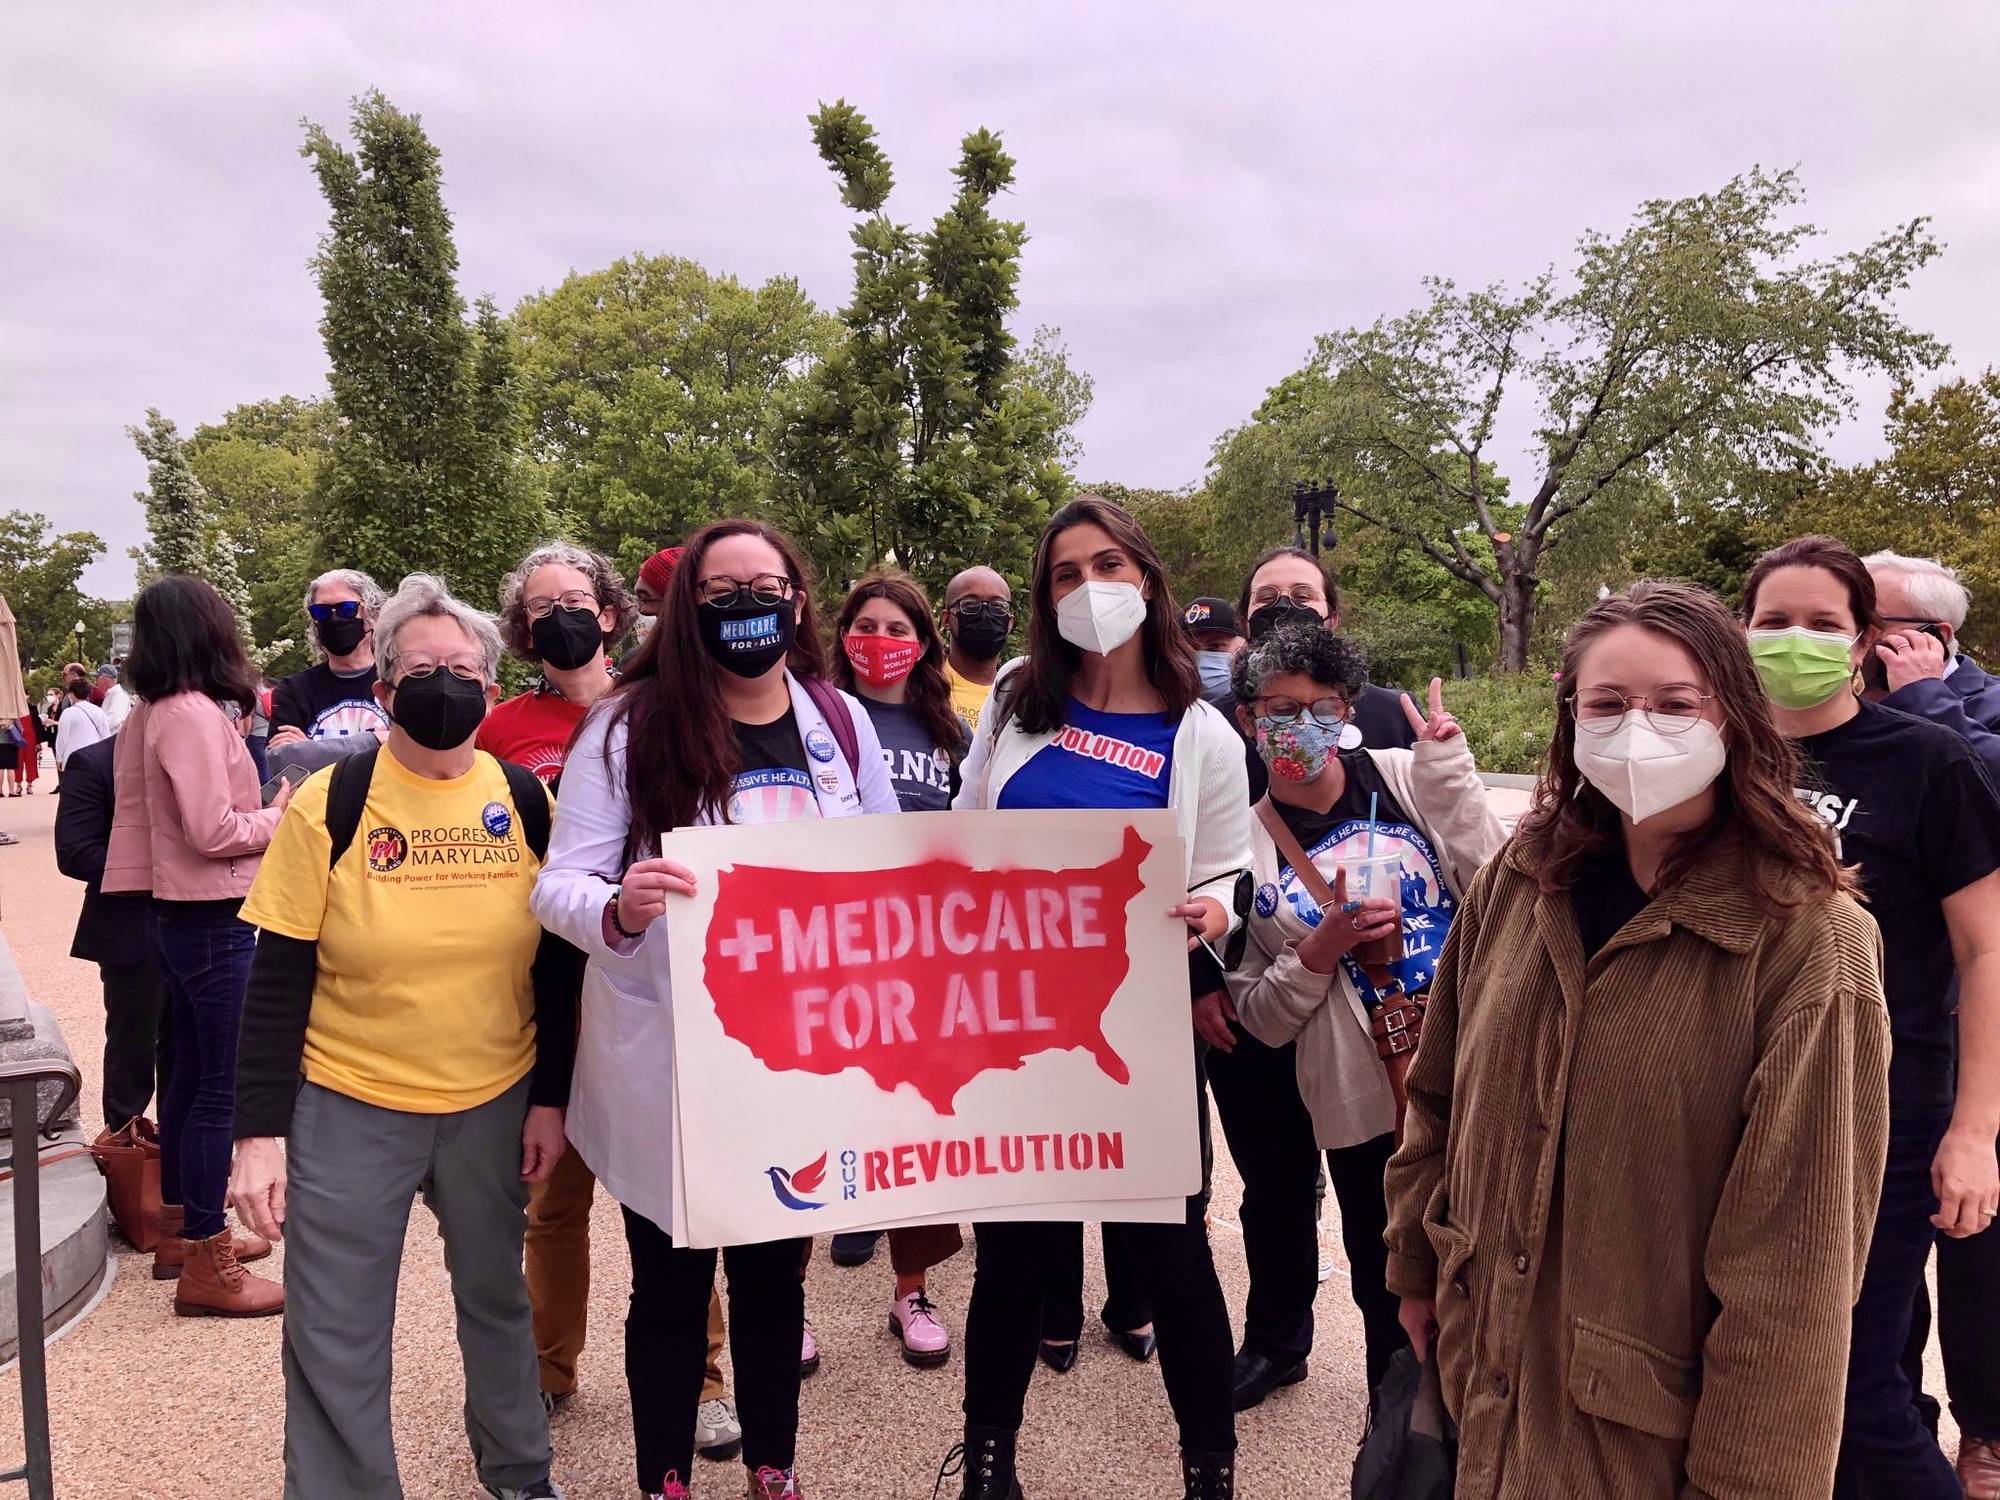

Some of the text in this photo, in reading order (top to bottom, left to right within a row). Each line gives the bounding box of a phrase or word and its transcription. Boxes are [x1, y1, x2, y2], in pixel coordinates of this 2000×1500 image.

[722, 616, 775, 638] MEDICARE
[731, 634, 780, 650] FOR ALL!
[883, 659, 906, 670] WORLD
[412, 847, 520, 866] MARYLAND
[1410, 833, 1446, 890] COALITION
[405, 872, 432, 882] Power
[435, 870, 449, 881] for
[451, 871, 485, 881] Working
[488, 870, 519, 879] Families
[778, 886, 1107, 974] MEDICARE
[791, 969, 1056, 1056] FOR ALL
[840, 1132, 1125, 1201] OUR REVOLUTION
